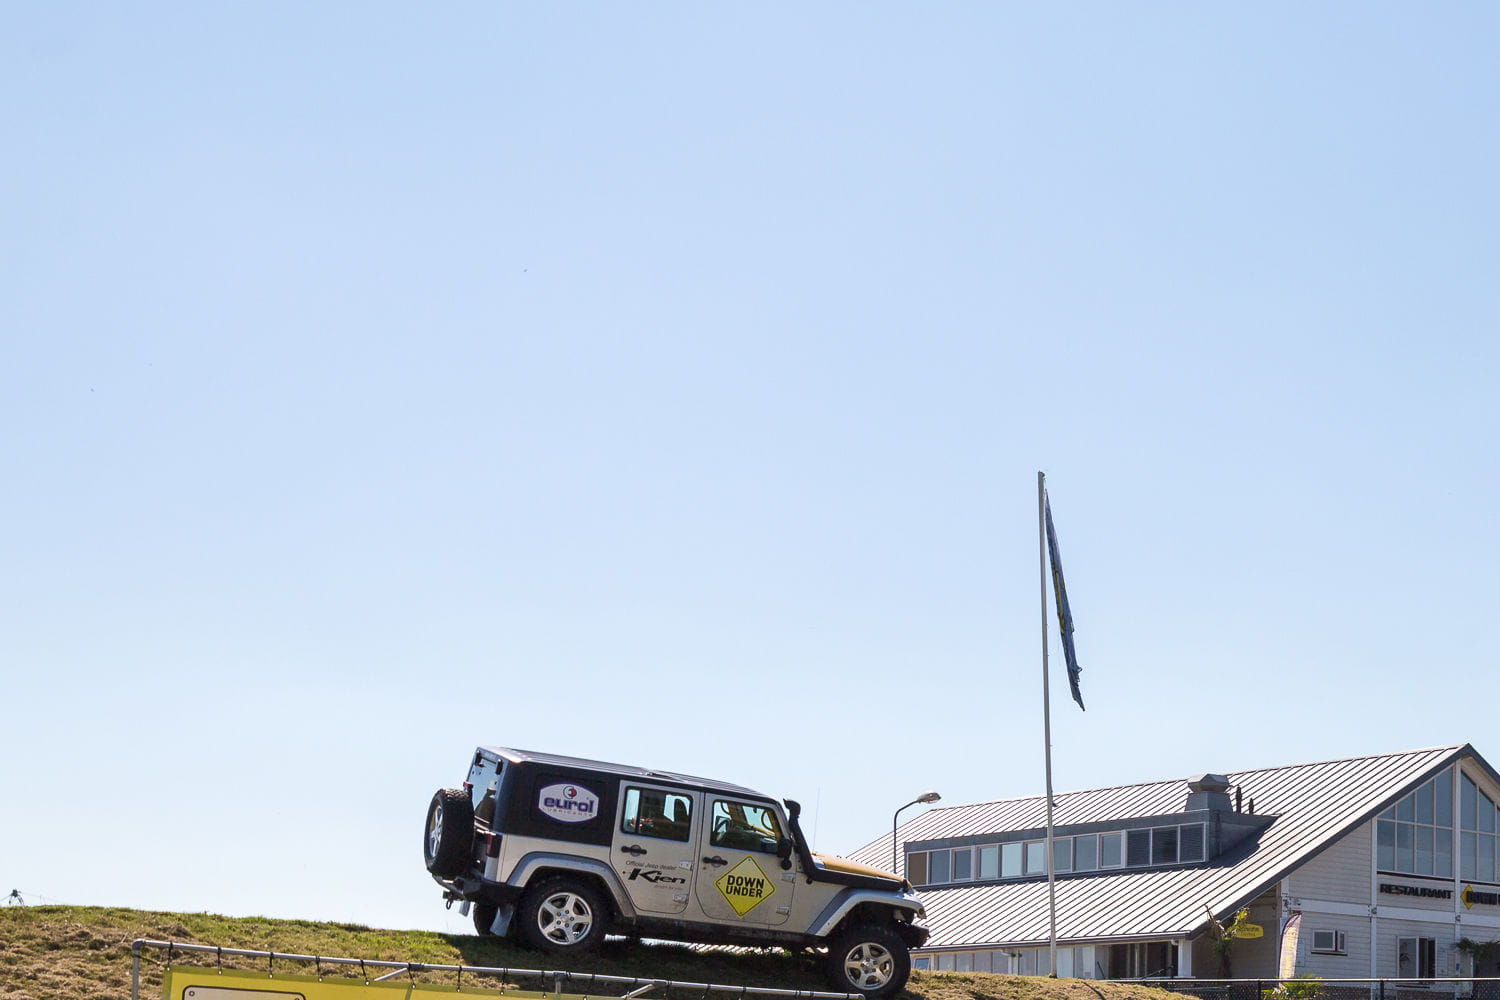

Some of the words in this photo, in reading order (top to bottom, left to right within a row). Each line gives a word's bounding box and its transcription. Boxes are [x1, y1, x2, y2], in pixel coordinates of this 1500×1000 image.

[544, 797, 594, 813] eurol
[628, 868, 686, 884] Kien
[727, 874, 765, 889] DOWN
[725, 886, 763, 898] UNDER
[1380, 883, 1454, 899] RESTAURANT
